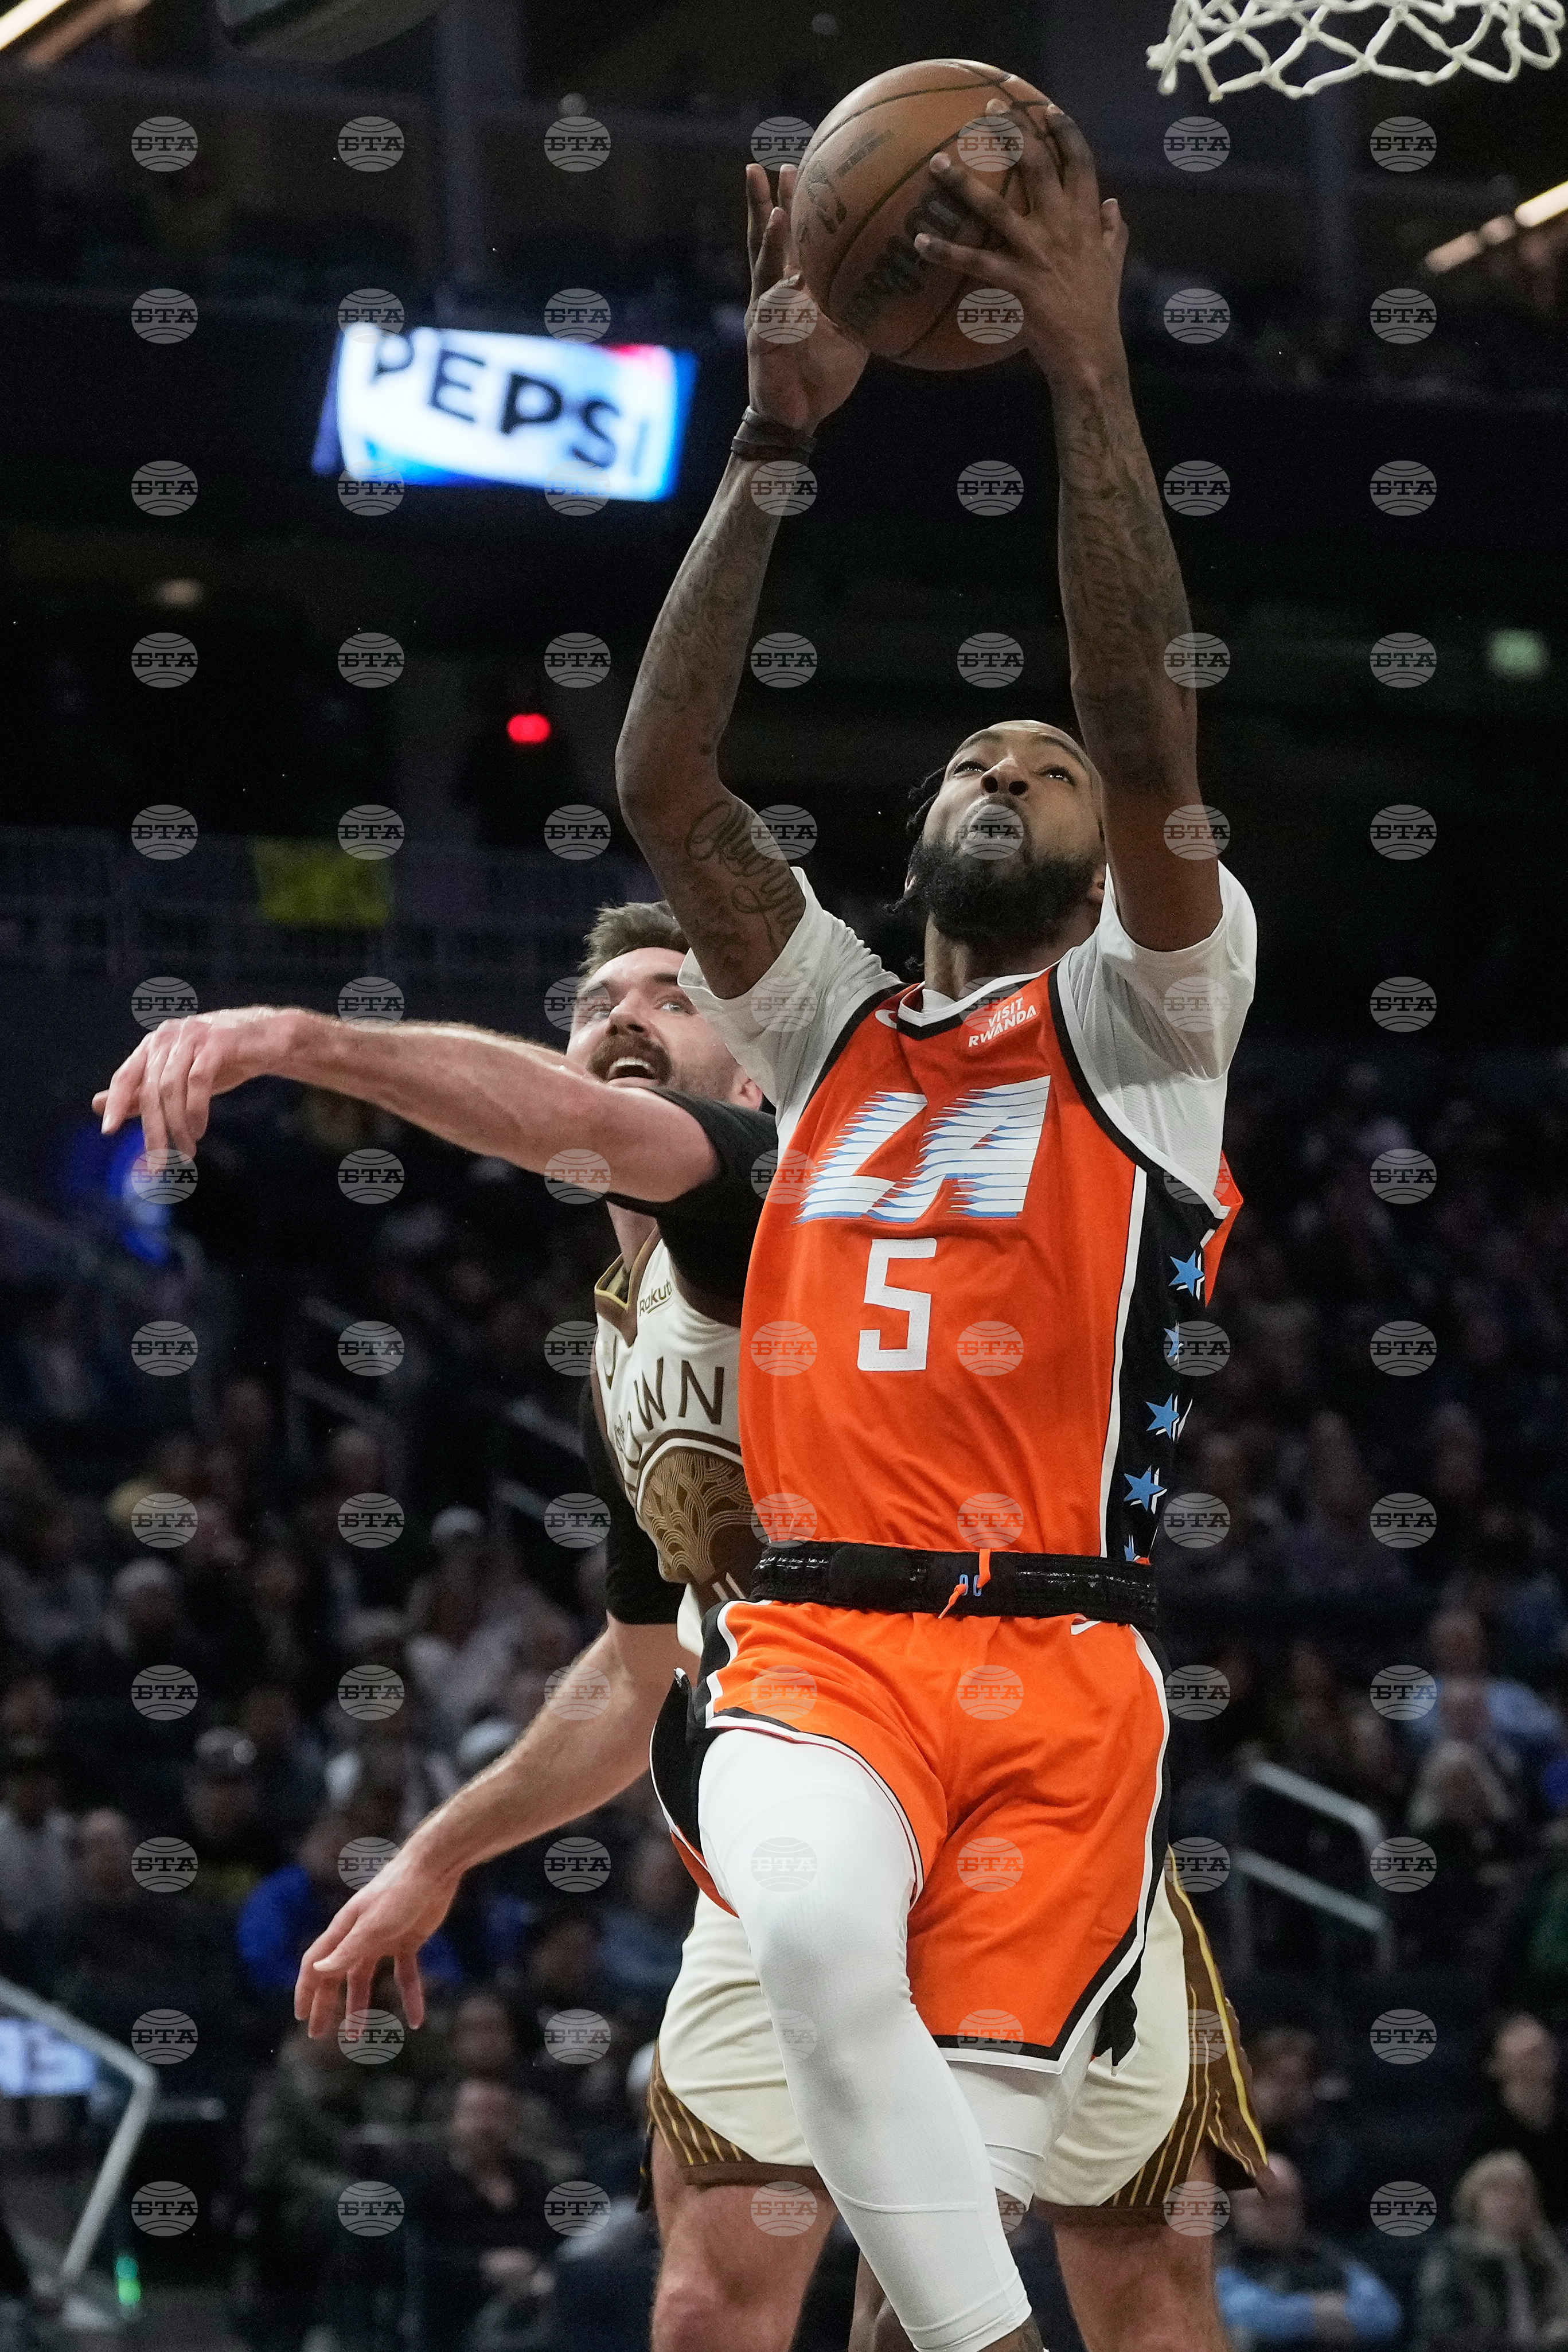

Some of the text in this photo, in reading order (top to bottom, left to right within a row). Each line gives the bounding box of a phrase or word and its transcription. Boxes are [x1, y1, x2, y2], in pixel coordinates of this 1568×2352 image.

[968, 1005, 1037, 1047] RWANDA
[988, 997, 1023, 1028] VISIT
[791, 1075, 1051, 1224] LA
[639, 1279, 672, 1317] Rakut
[857, 1238, 937, 1372] 5
